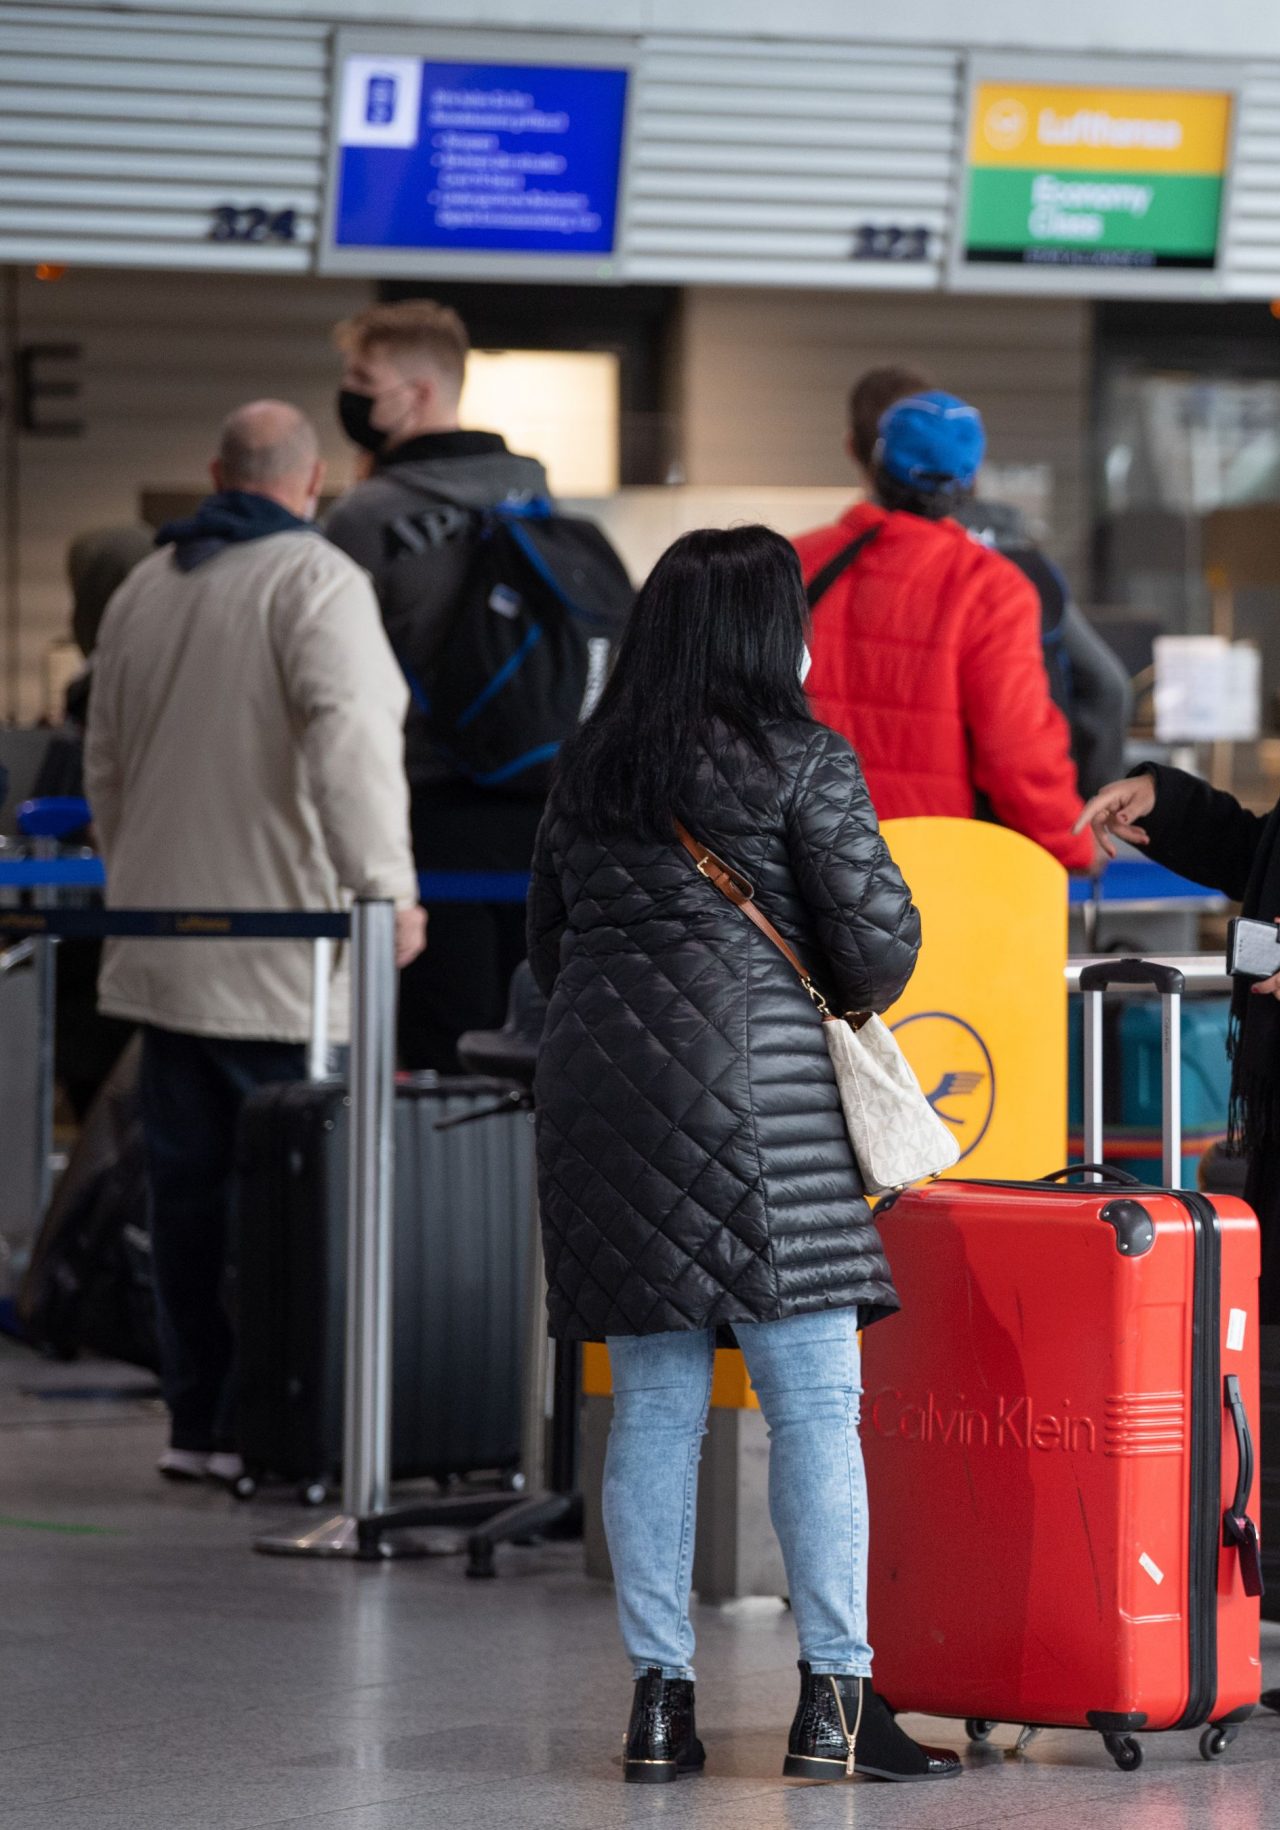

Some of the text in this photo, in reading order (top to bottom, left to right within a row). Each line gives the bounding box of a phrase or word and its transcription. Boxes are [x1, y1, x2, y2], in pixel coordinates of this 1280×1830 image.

[1031, 174, 1154, 219] Economy
[207, 205, 296, 242] 324
[873, 1386, 1097, 1453] Calvin Klein
